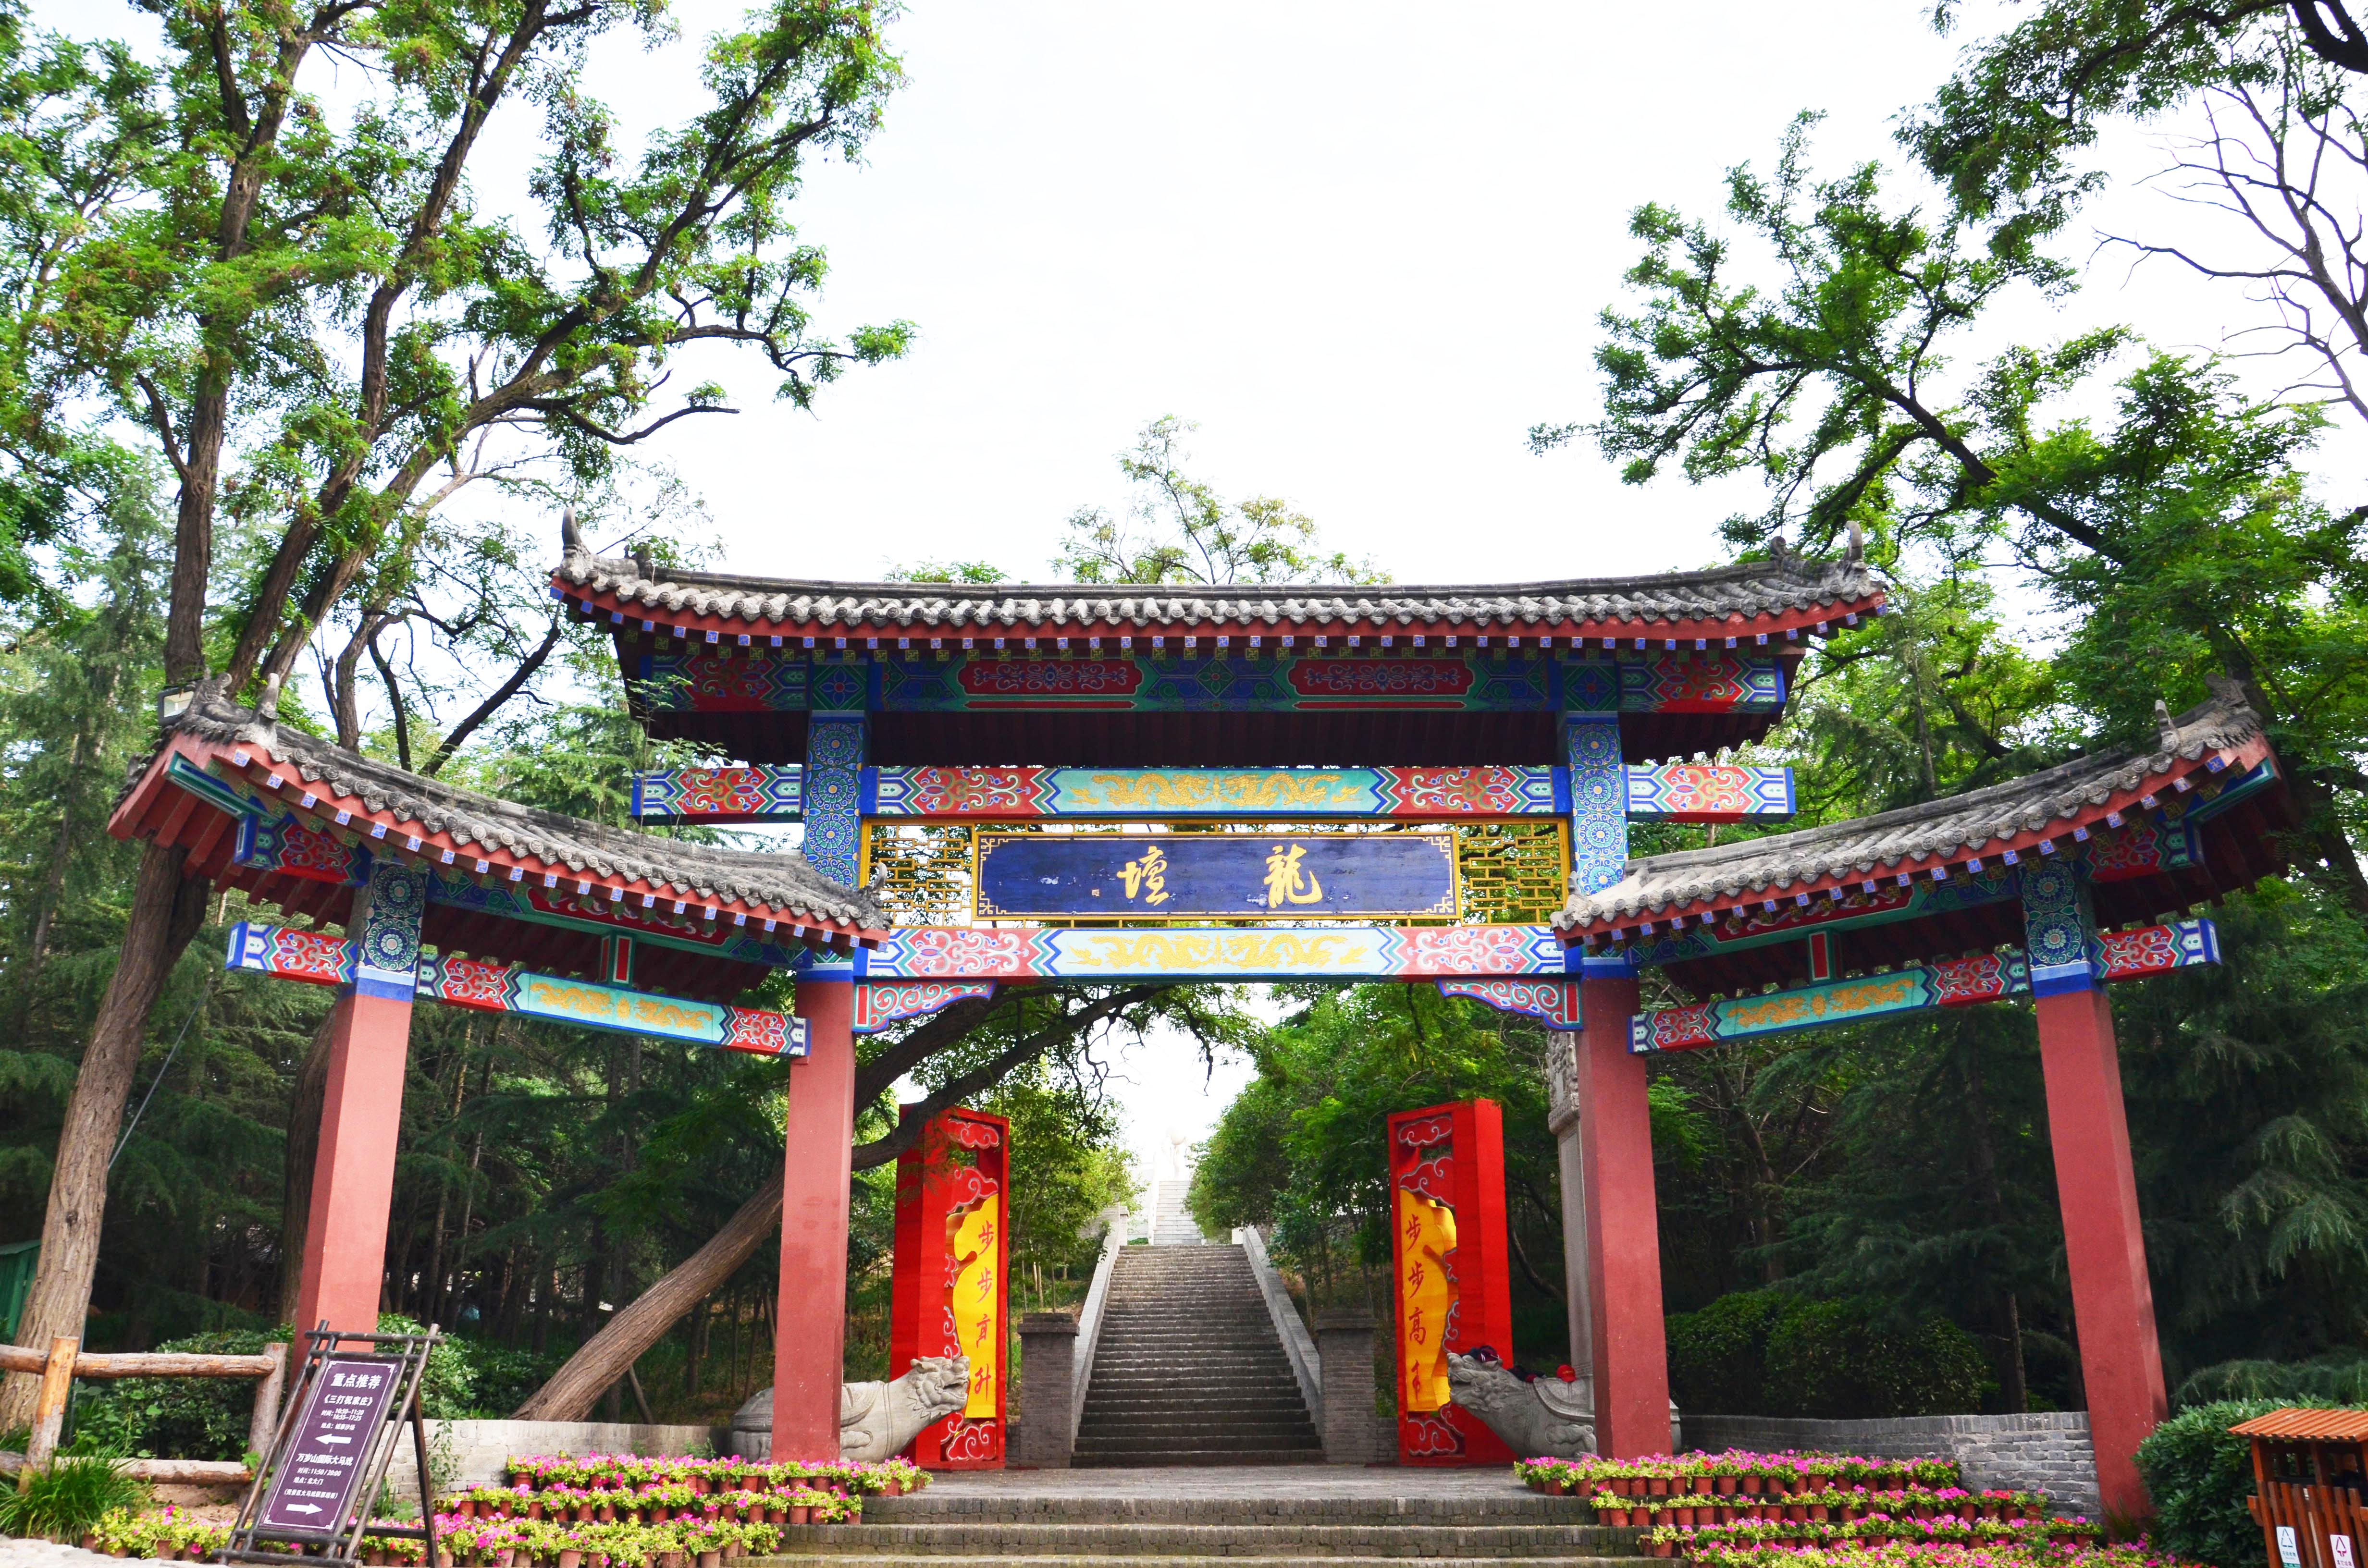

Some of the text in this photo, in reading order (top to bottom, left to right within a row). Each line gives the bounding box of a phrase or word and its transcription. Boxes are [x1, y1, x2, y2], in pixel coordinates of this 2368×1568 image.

[331, 1373, 382, 1389] 重点推荐
[324, 1394, 373, 1406] 《三打祝家庄》
[296, 1453, 354, 1466] 万岁山国际大马戏
